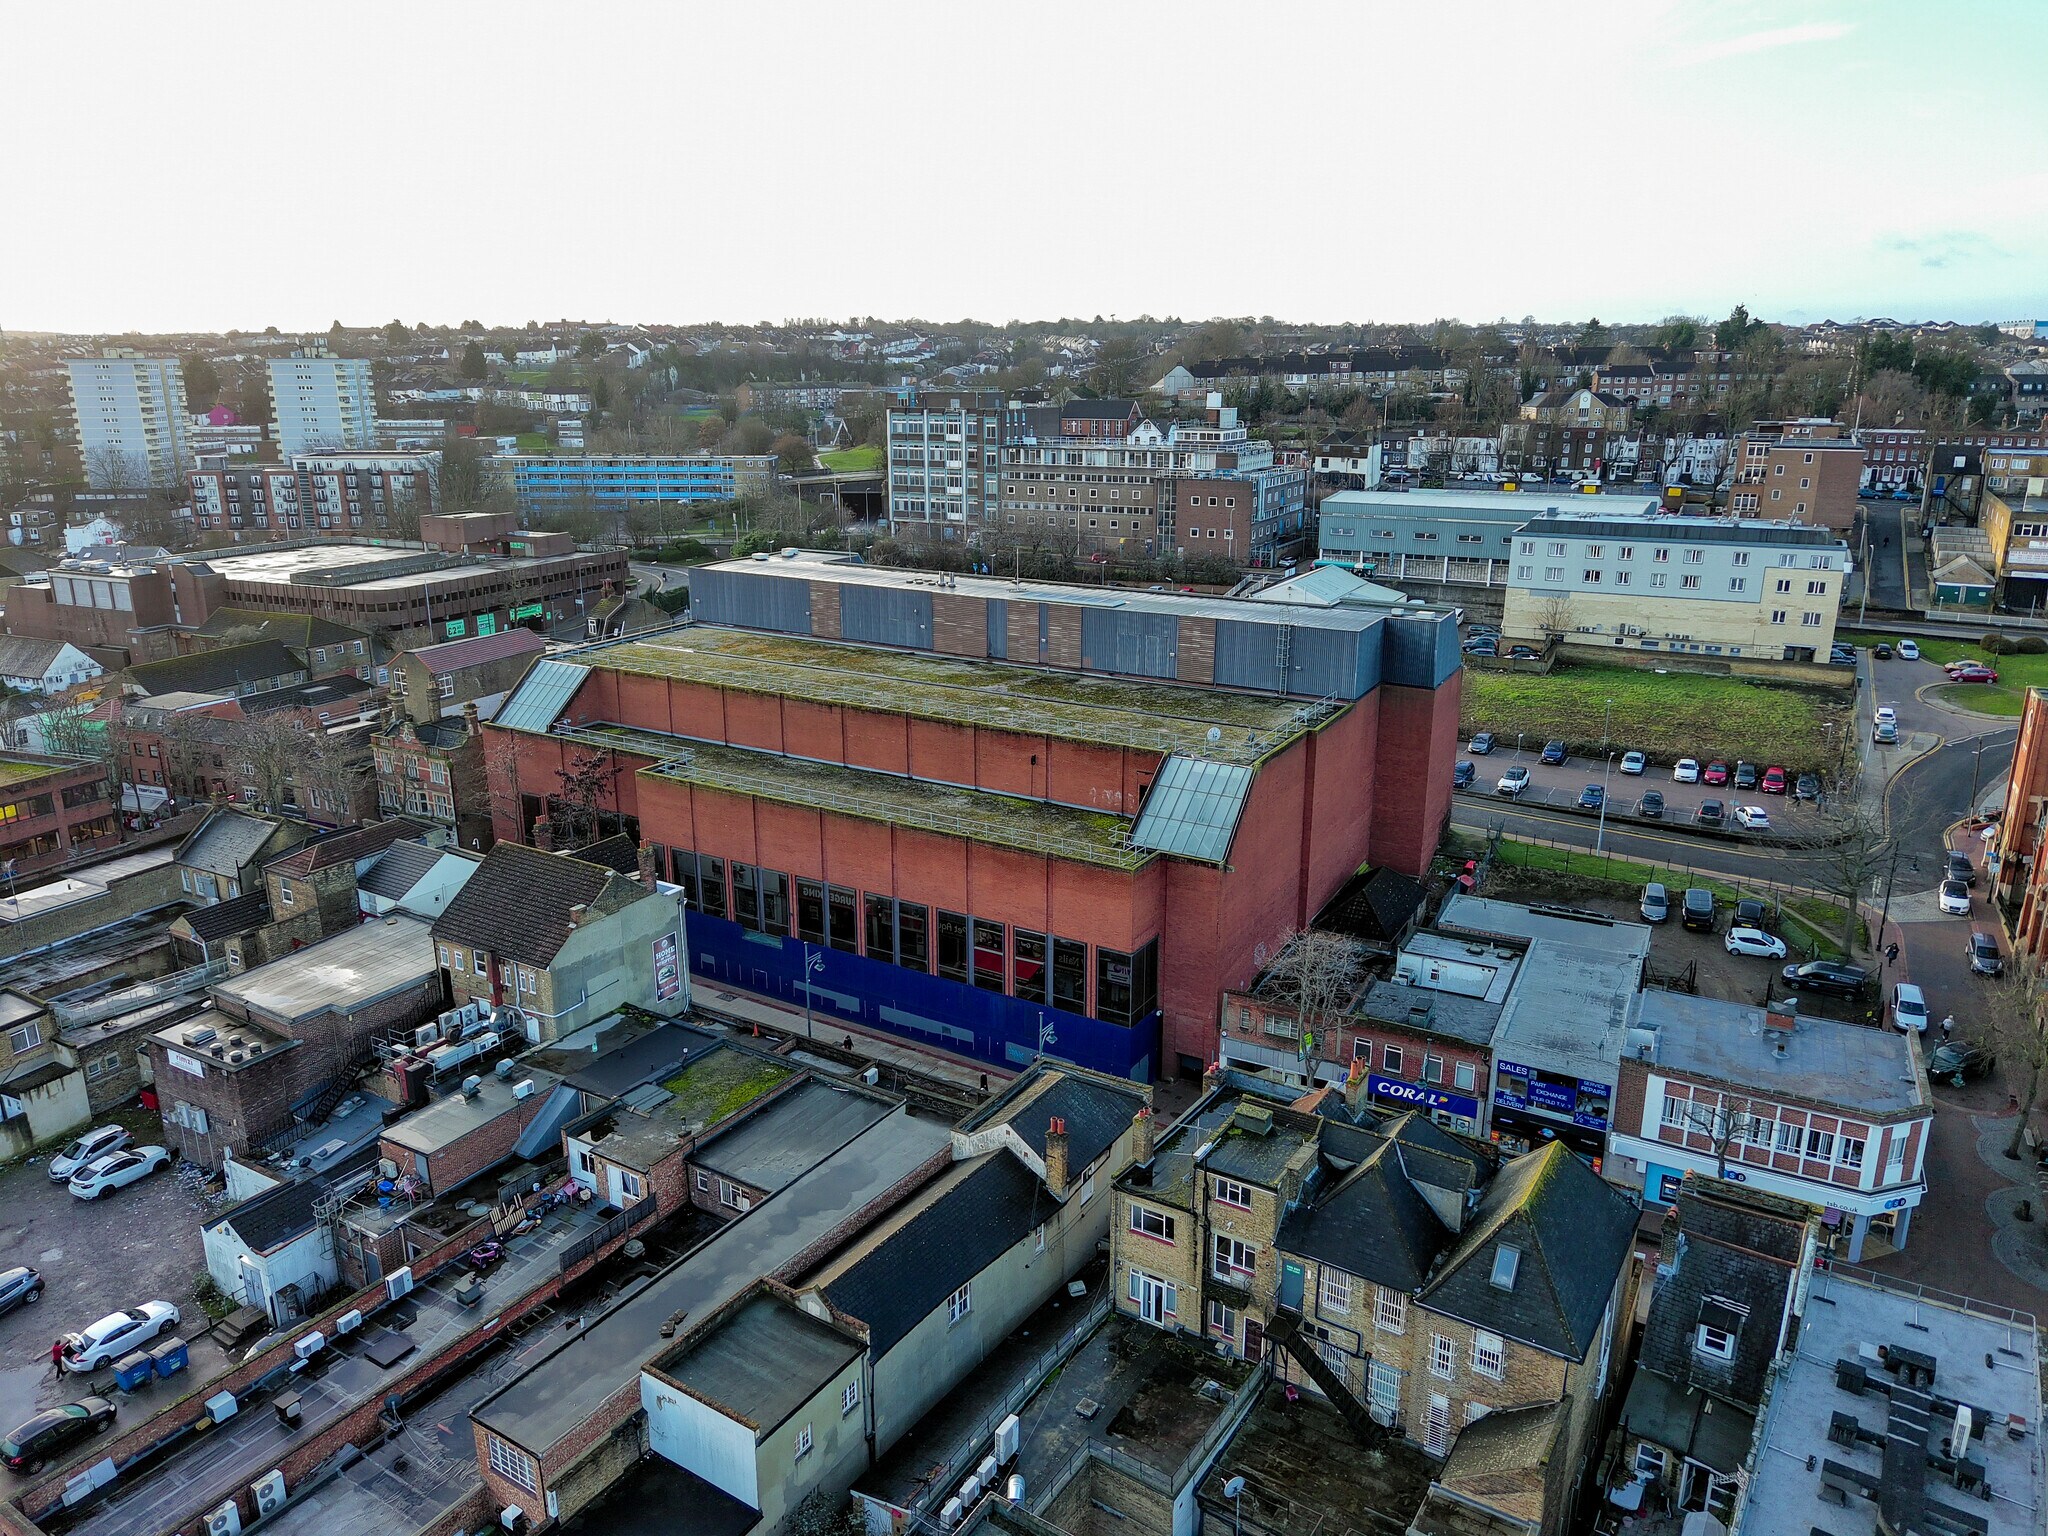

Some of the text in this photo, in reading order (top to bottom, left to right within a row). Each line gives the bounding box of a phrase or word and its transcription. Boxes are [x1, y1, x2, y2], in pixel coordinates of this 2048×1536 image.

[655, 945, 675, 960] HOME
[1499, 1062, 1528, 1075] SALES
[1530, 1080, 1547, 1089] PART
[1580, 1085, 1607, 1097] REPAIRS
[1377, 1082, 1438, 1106] CORAL
[1503, 1094, 1517, 1103] FREE
[1535, 1088, 1568, 1101] EXCHANGE
[1495, 1097, 1524, 1109] DELIVERY
[1826, 1200, 1859, 1213] tsb.co.uk
